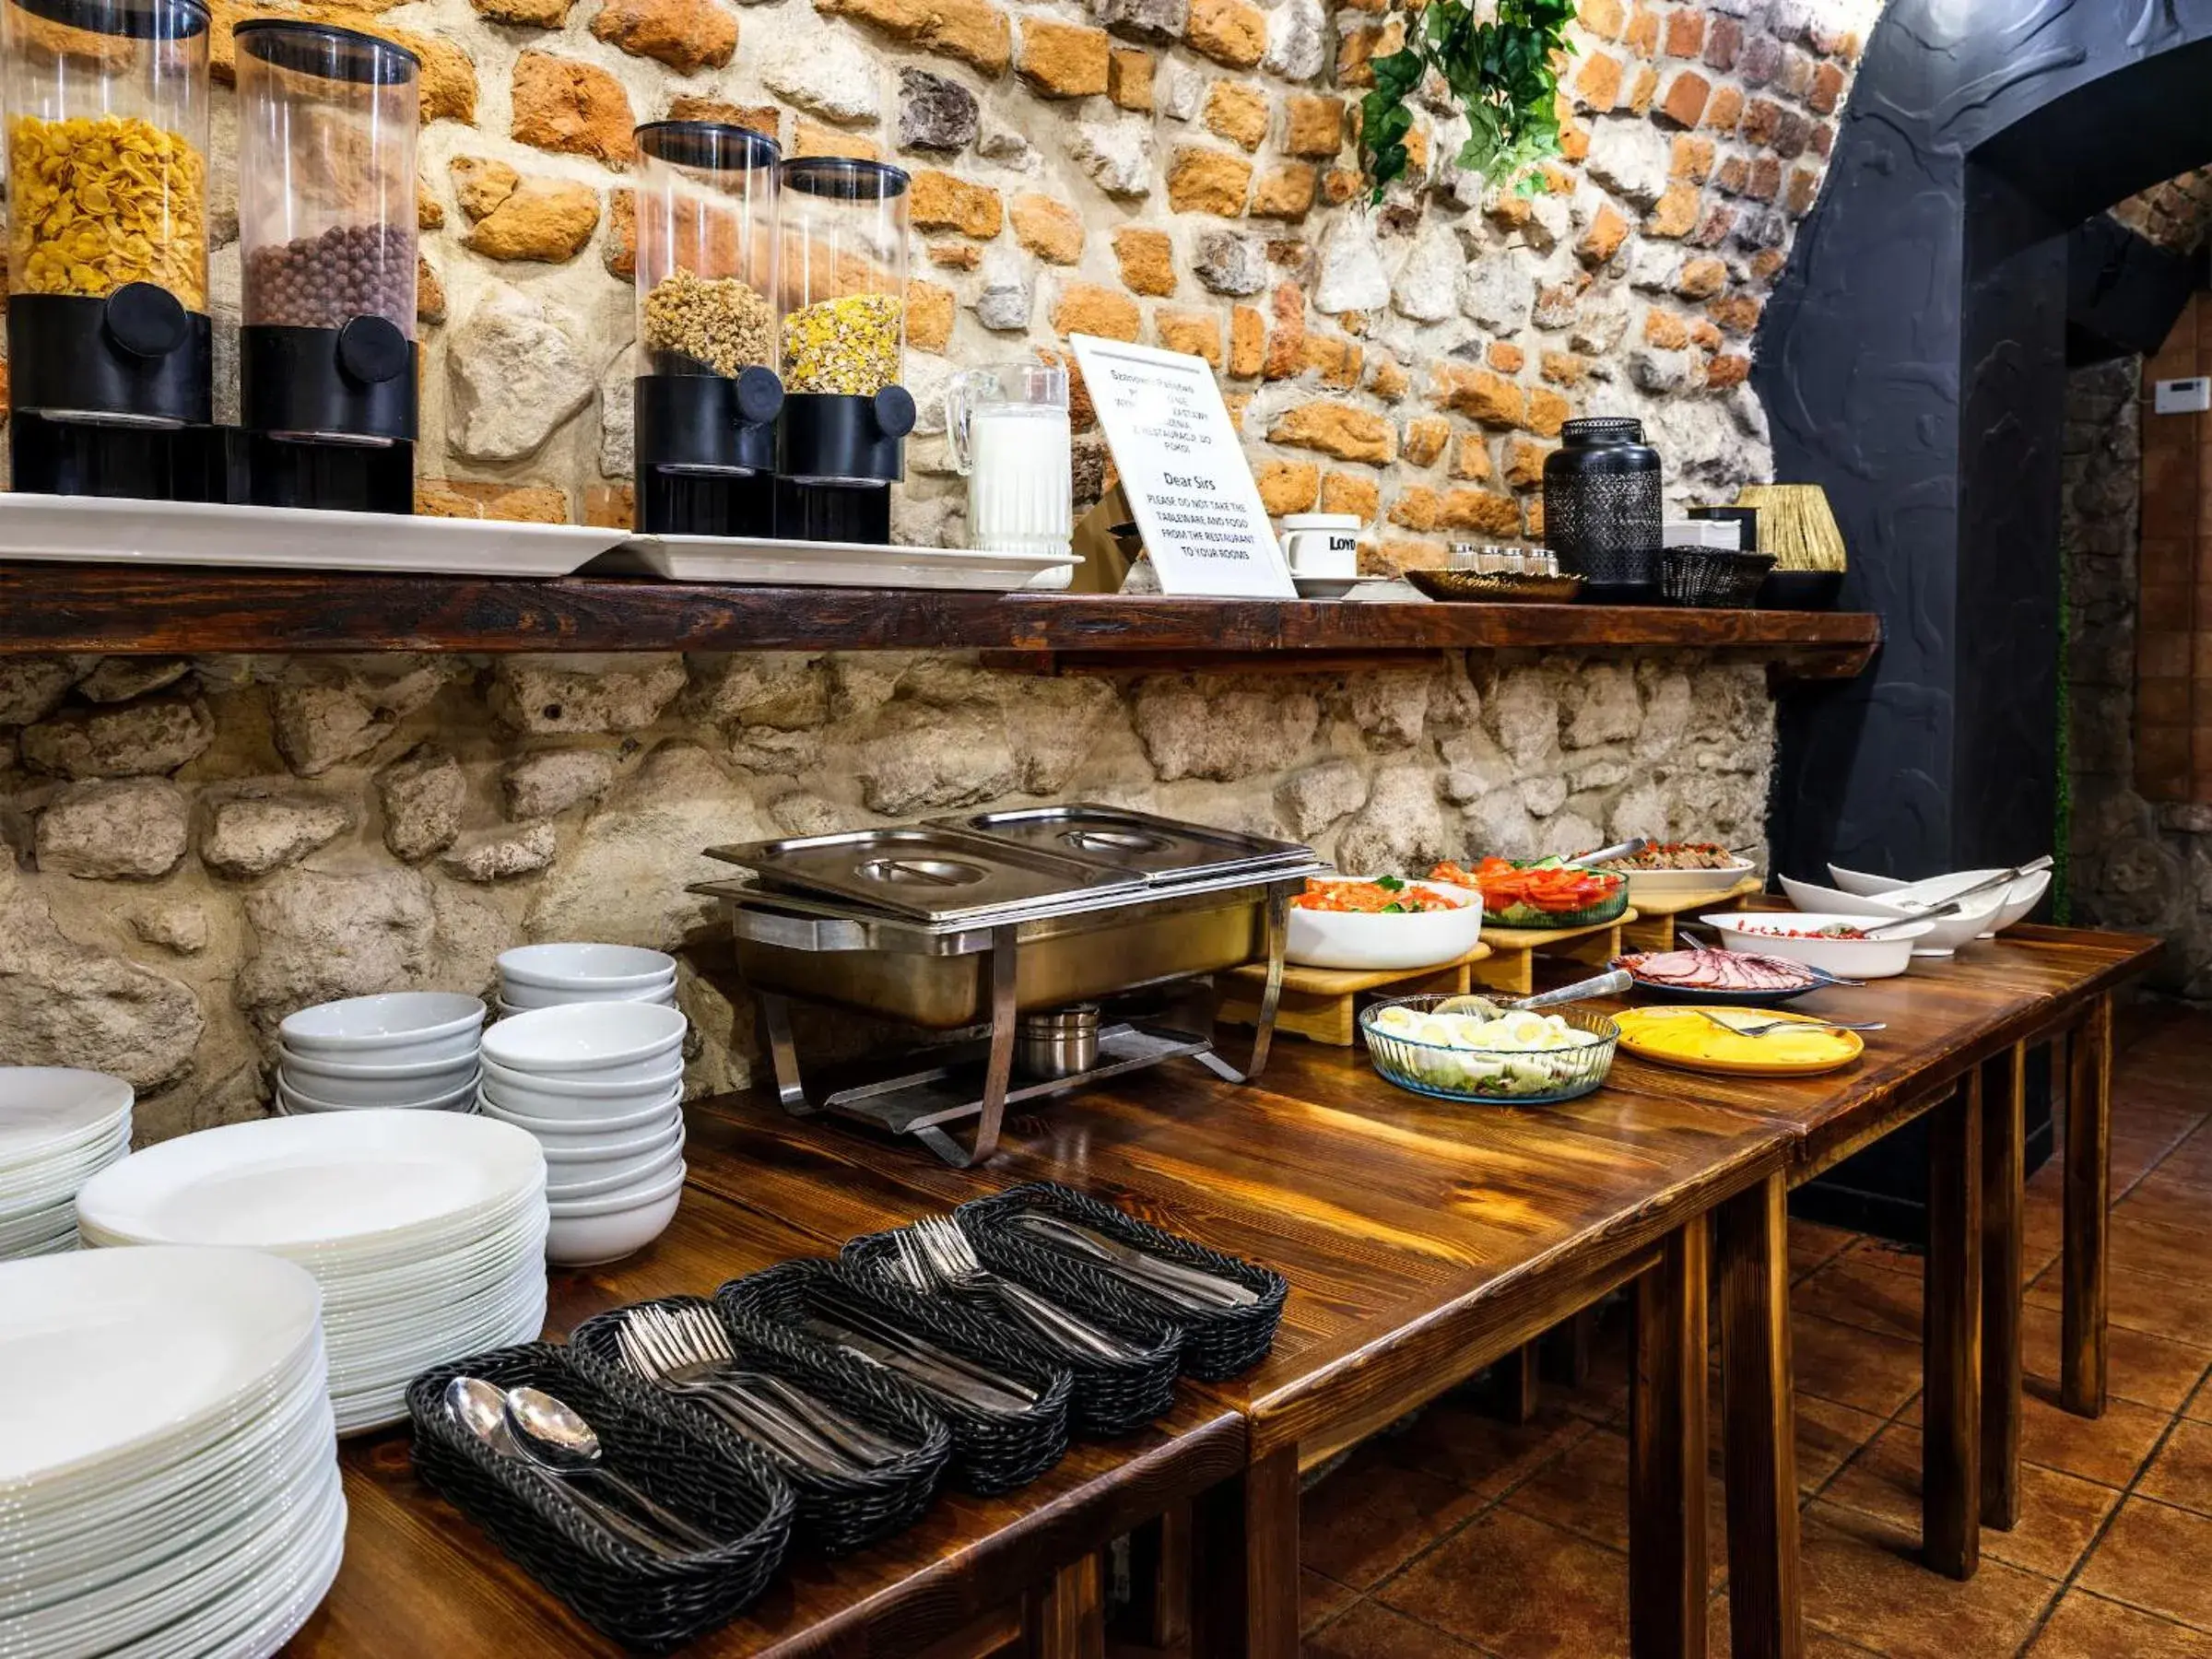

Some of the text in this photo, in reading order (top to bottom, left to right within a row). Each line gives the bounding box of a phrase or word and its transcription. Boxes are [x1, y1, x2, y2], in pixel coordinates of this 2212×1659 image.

[1163, 472, 1216, 490] Dear Sirs
[1147, 494, 1246, 513] PLEASE DO NOT TAKE THE
[1156, 512, 1248, 528] TABLEWARE AND FOOD
[1161, 528, 1253, 544] FROM THE RESTAURANT
[1181, 546, 1250, 559] TO YOUR ROOMS
